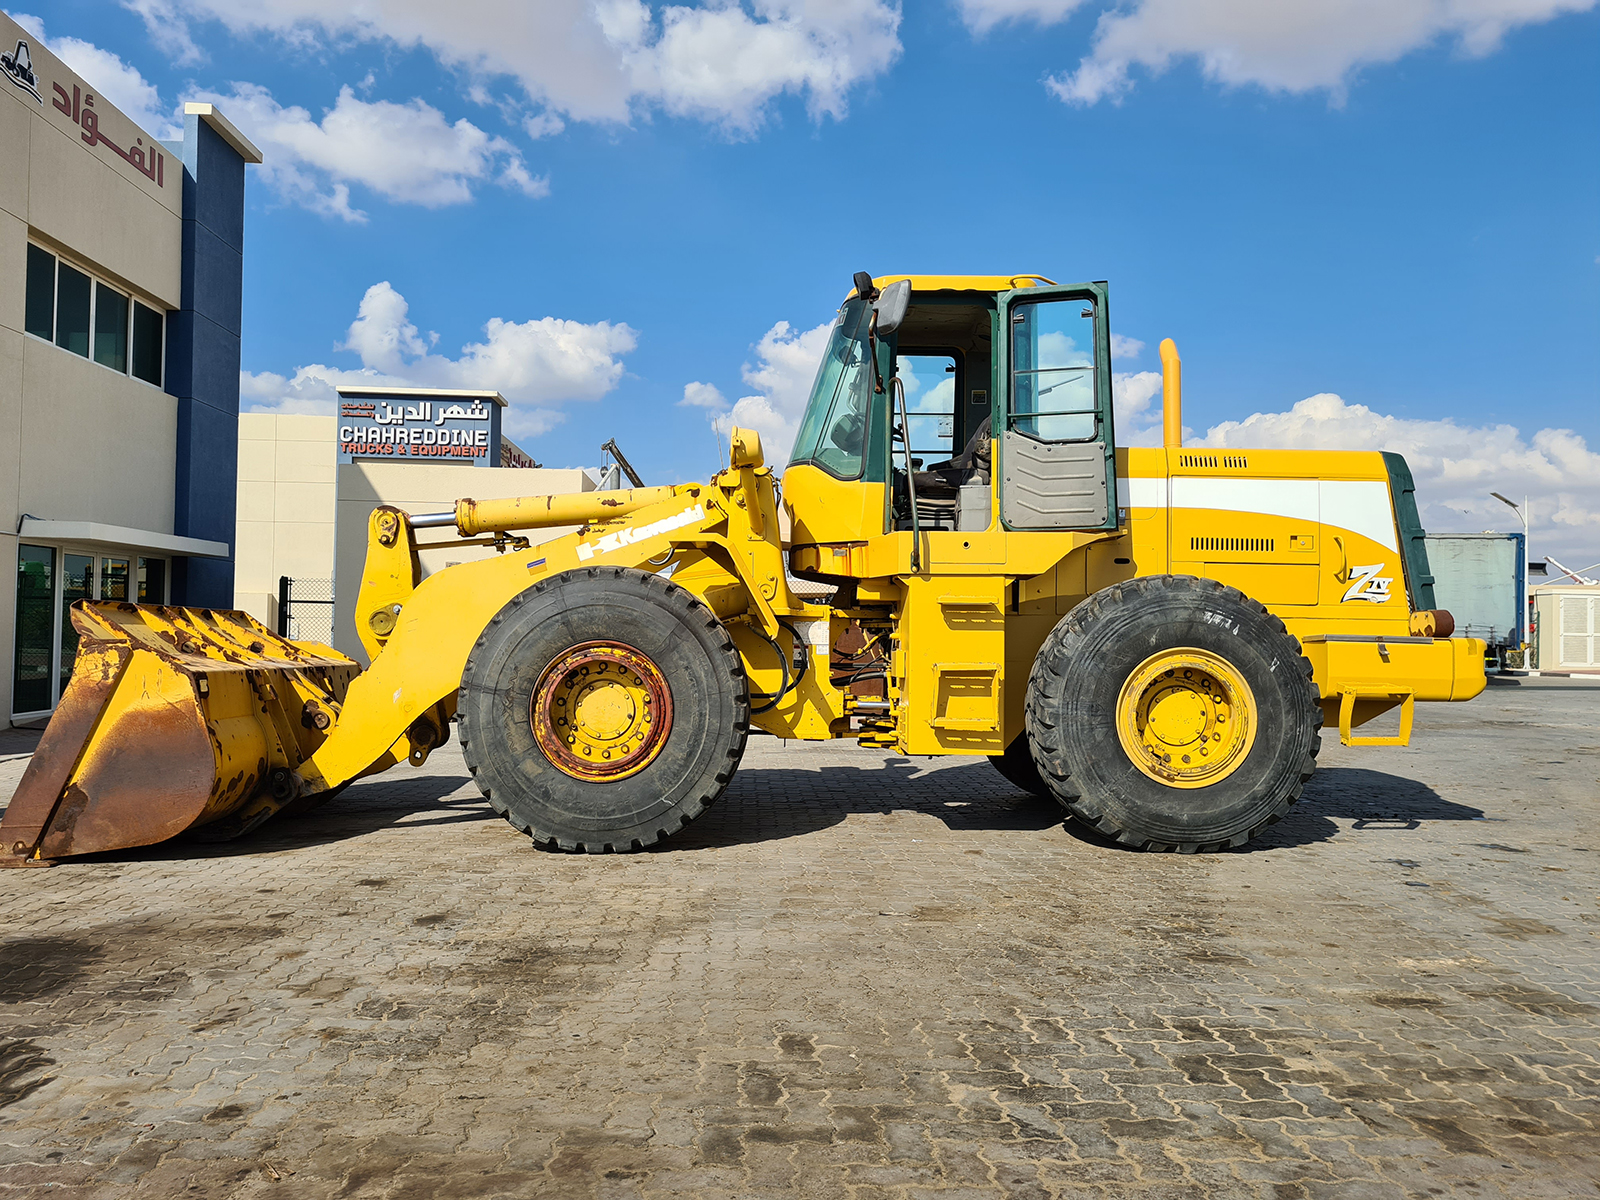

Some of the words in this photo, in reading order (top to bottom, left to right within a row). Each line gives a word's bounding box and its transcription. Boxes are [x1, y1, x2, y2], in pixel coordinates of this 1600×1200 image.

[53, 81, 164, 188] الفؤاد
[375, 402, 432, 424] الدين
[434, 399, 488, 426] شهر
[340, 426, 488, 446] CHAHREDDINE
[340, 442, 393, 454] TRUCKS
[397, 444, 406, 454] &
[410, 444, 487, 456] EQUIPMENT
